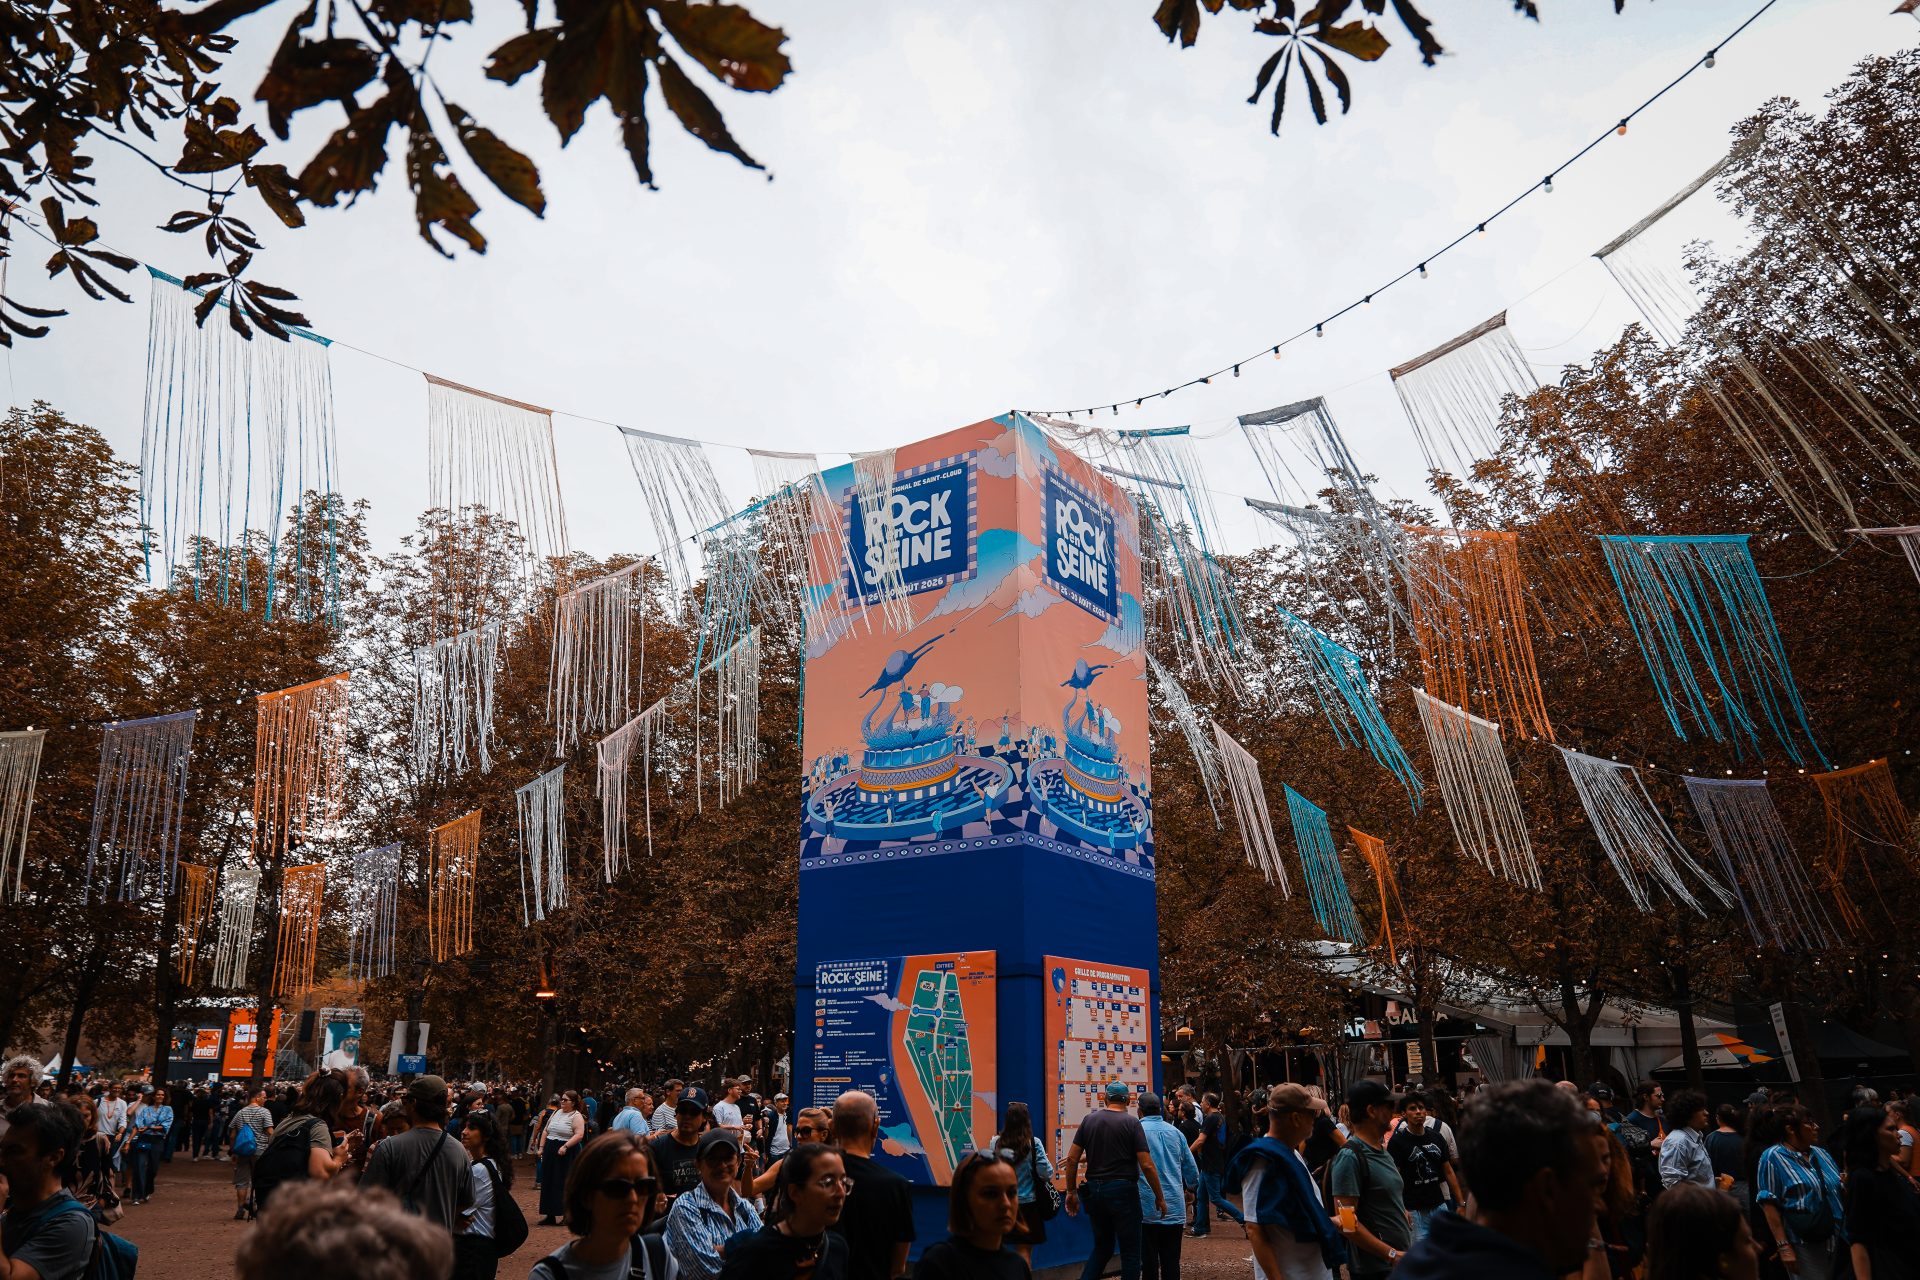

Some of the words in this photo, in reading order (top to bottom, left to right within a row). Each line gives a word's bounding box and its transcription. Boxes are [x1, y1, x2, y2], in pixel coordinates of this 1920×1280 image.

[913, 479, 921, 488] DE
[922, 468, 962, 485] SAINT-CLOUD
[865, 489, 952, 546] ROCK
[1055, 498, 1107, 566] ROCK
[1069, 533, 1081, 547] en
[863, 526, 952, 585] SEINE
[1056, 537, 1108, 597] SEINE
[868, 592, 878, 602] 26
[921, 577, 944, 590] 2026
[1060, 585, 1068, 596] 26
[821, 971, 850, 985] ROCK
[854, 970, 882, 986] SEINE
[1074, 967, 1089, 977] GRILLE
[1089, 969, 1096, 978] DE
[194, 1046, 216, 1057] inter
